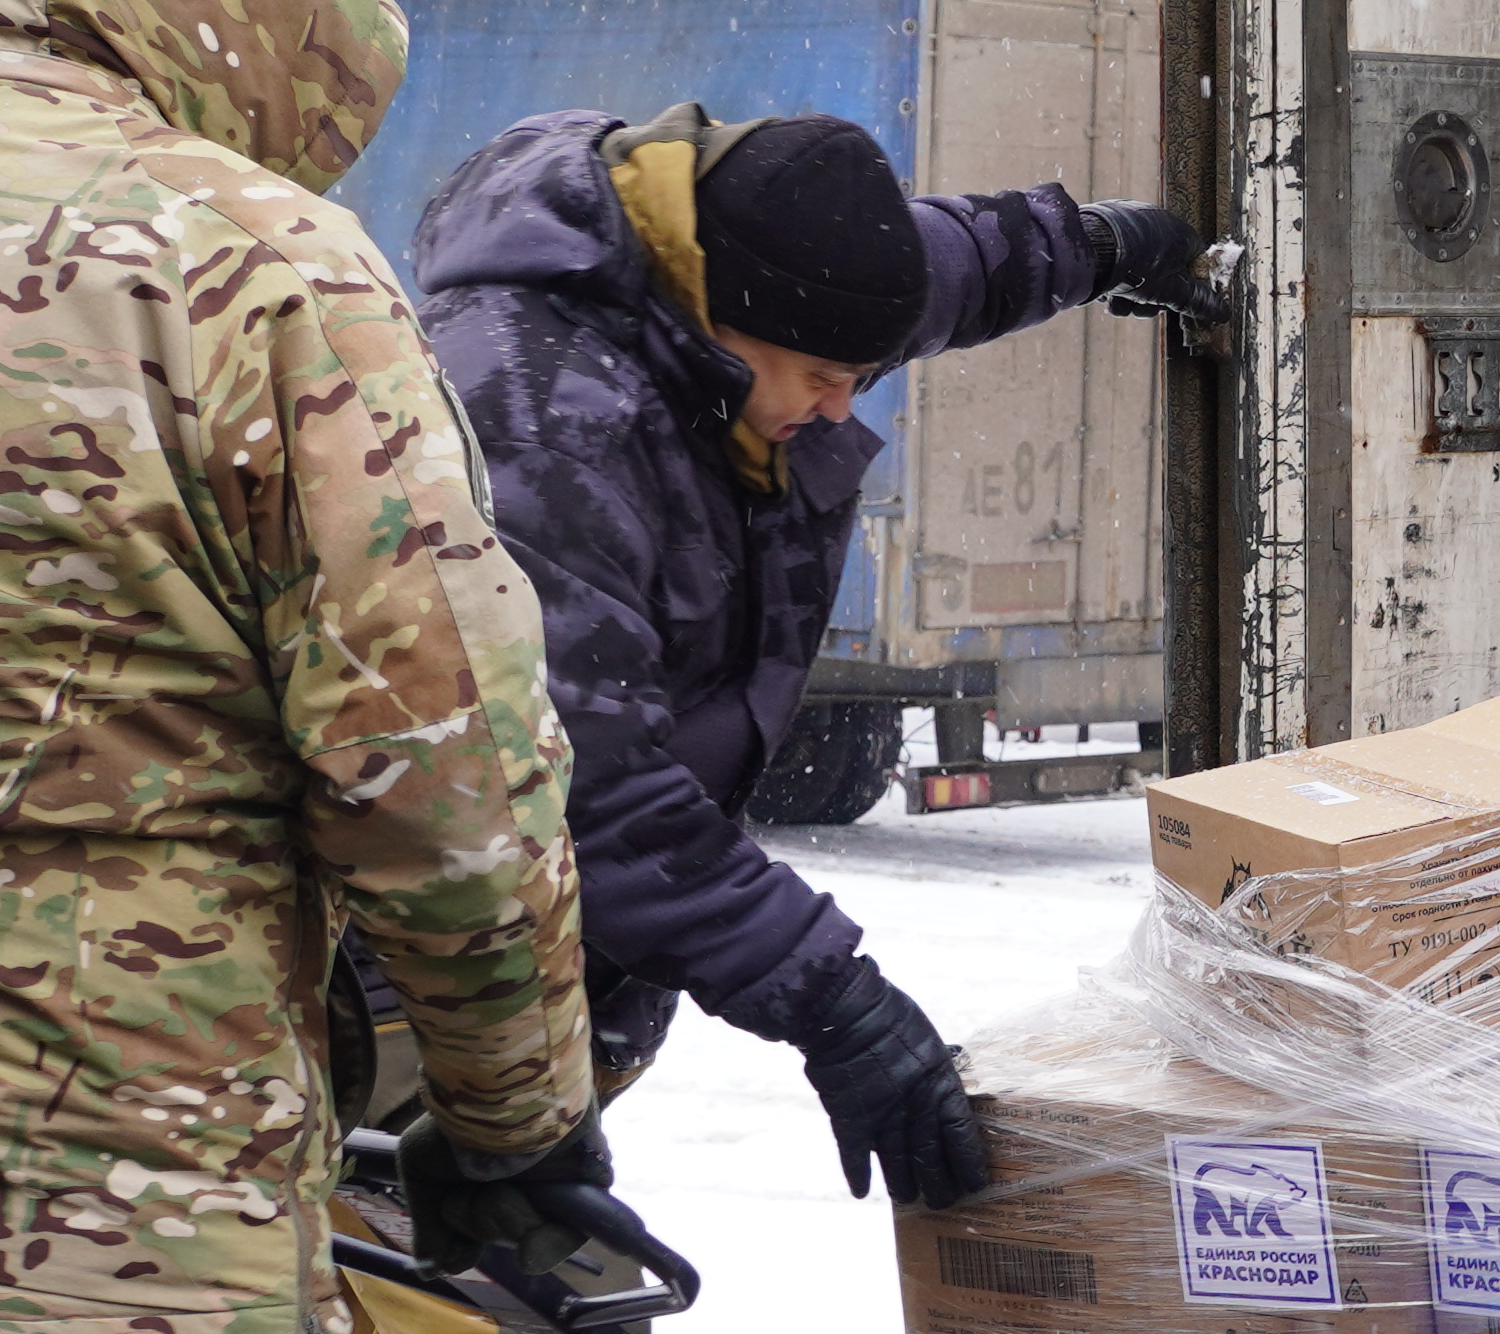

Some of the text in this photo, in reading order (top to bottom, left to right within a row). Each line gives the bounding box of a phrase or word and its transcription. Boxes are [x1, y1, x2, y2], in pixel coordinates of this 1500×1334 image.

[1157, 814, 1191, 839] 105084
[1410, 874, 1456, 890] отдельно
[1392, 910, 1416, 923] Срок
[1418, 901, 1462, 917] годности
[1388, 938, 1412, 959] ТУ
[1195, 1247, 1318, 1266] ЕДИНАЯ РОССИЯ
[1198, 1264, 1319, 1287] КРАСНОДАР
